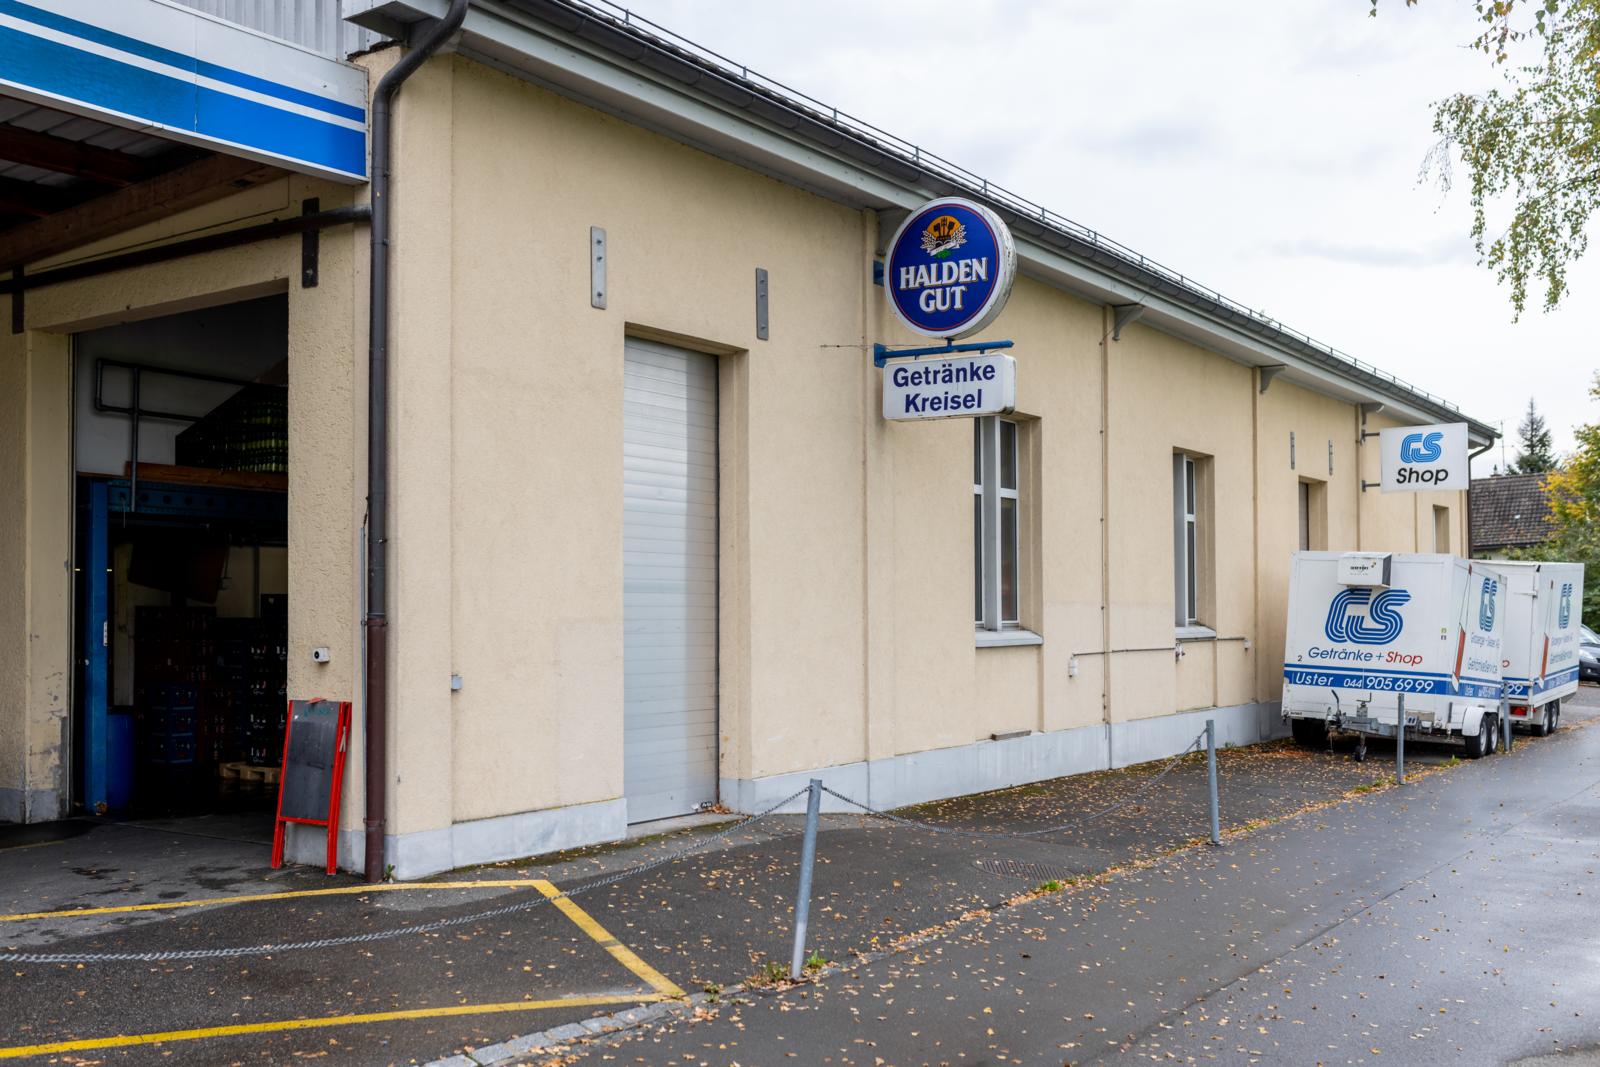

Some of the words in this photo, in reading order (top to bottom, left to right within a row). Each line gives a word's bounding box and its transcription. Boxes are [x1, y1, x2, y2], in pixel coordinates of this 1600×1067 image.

[900, 257, 988, 290] HALDEN
[919, 286, 967, 313] GUT
[893, 362, 996, 388] Getränke
[905, 389, 982, 413] Kreisel
[1396, 467, 1449, 485] Shop
[1308, 646, 1374, 662] Getränke
[1386, 651, 1423, 667] Shop
[1296, 672, 1334, 686] Uster
[1343, 678, 1362, 688] 044
[1366, 676, 1393, 690] 905
[1395, 678, 1414, 692] 69
[1415, 680, 1434, 693] 99
